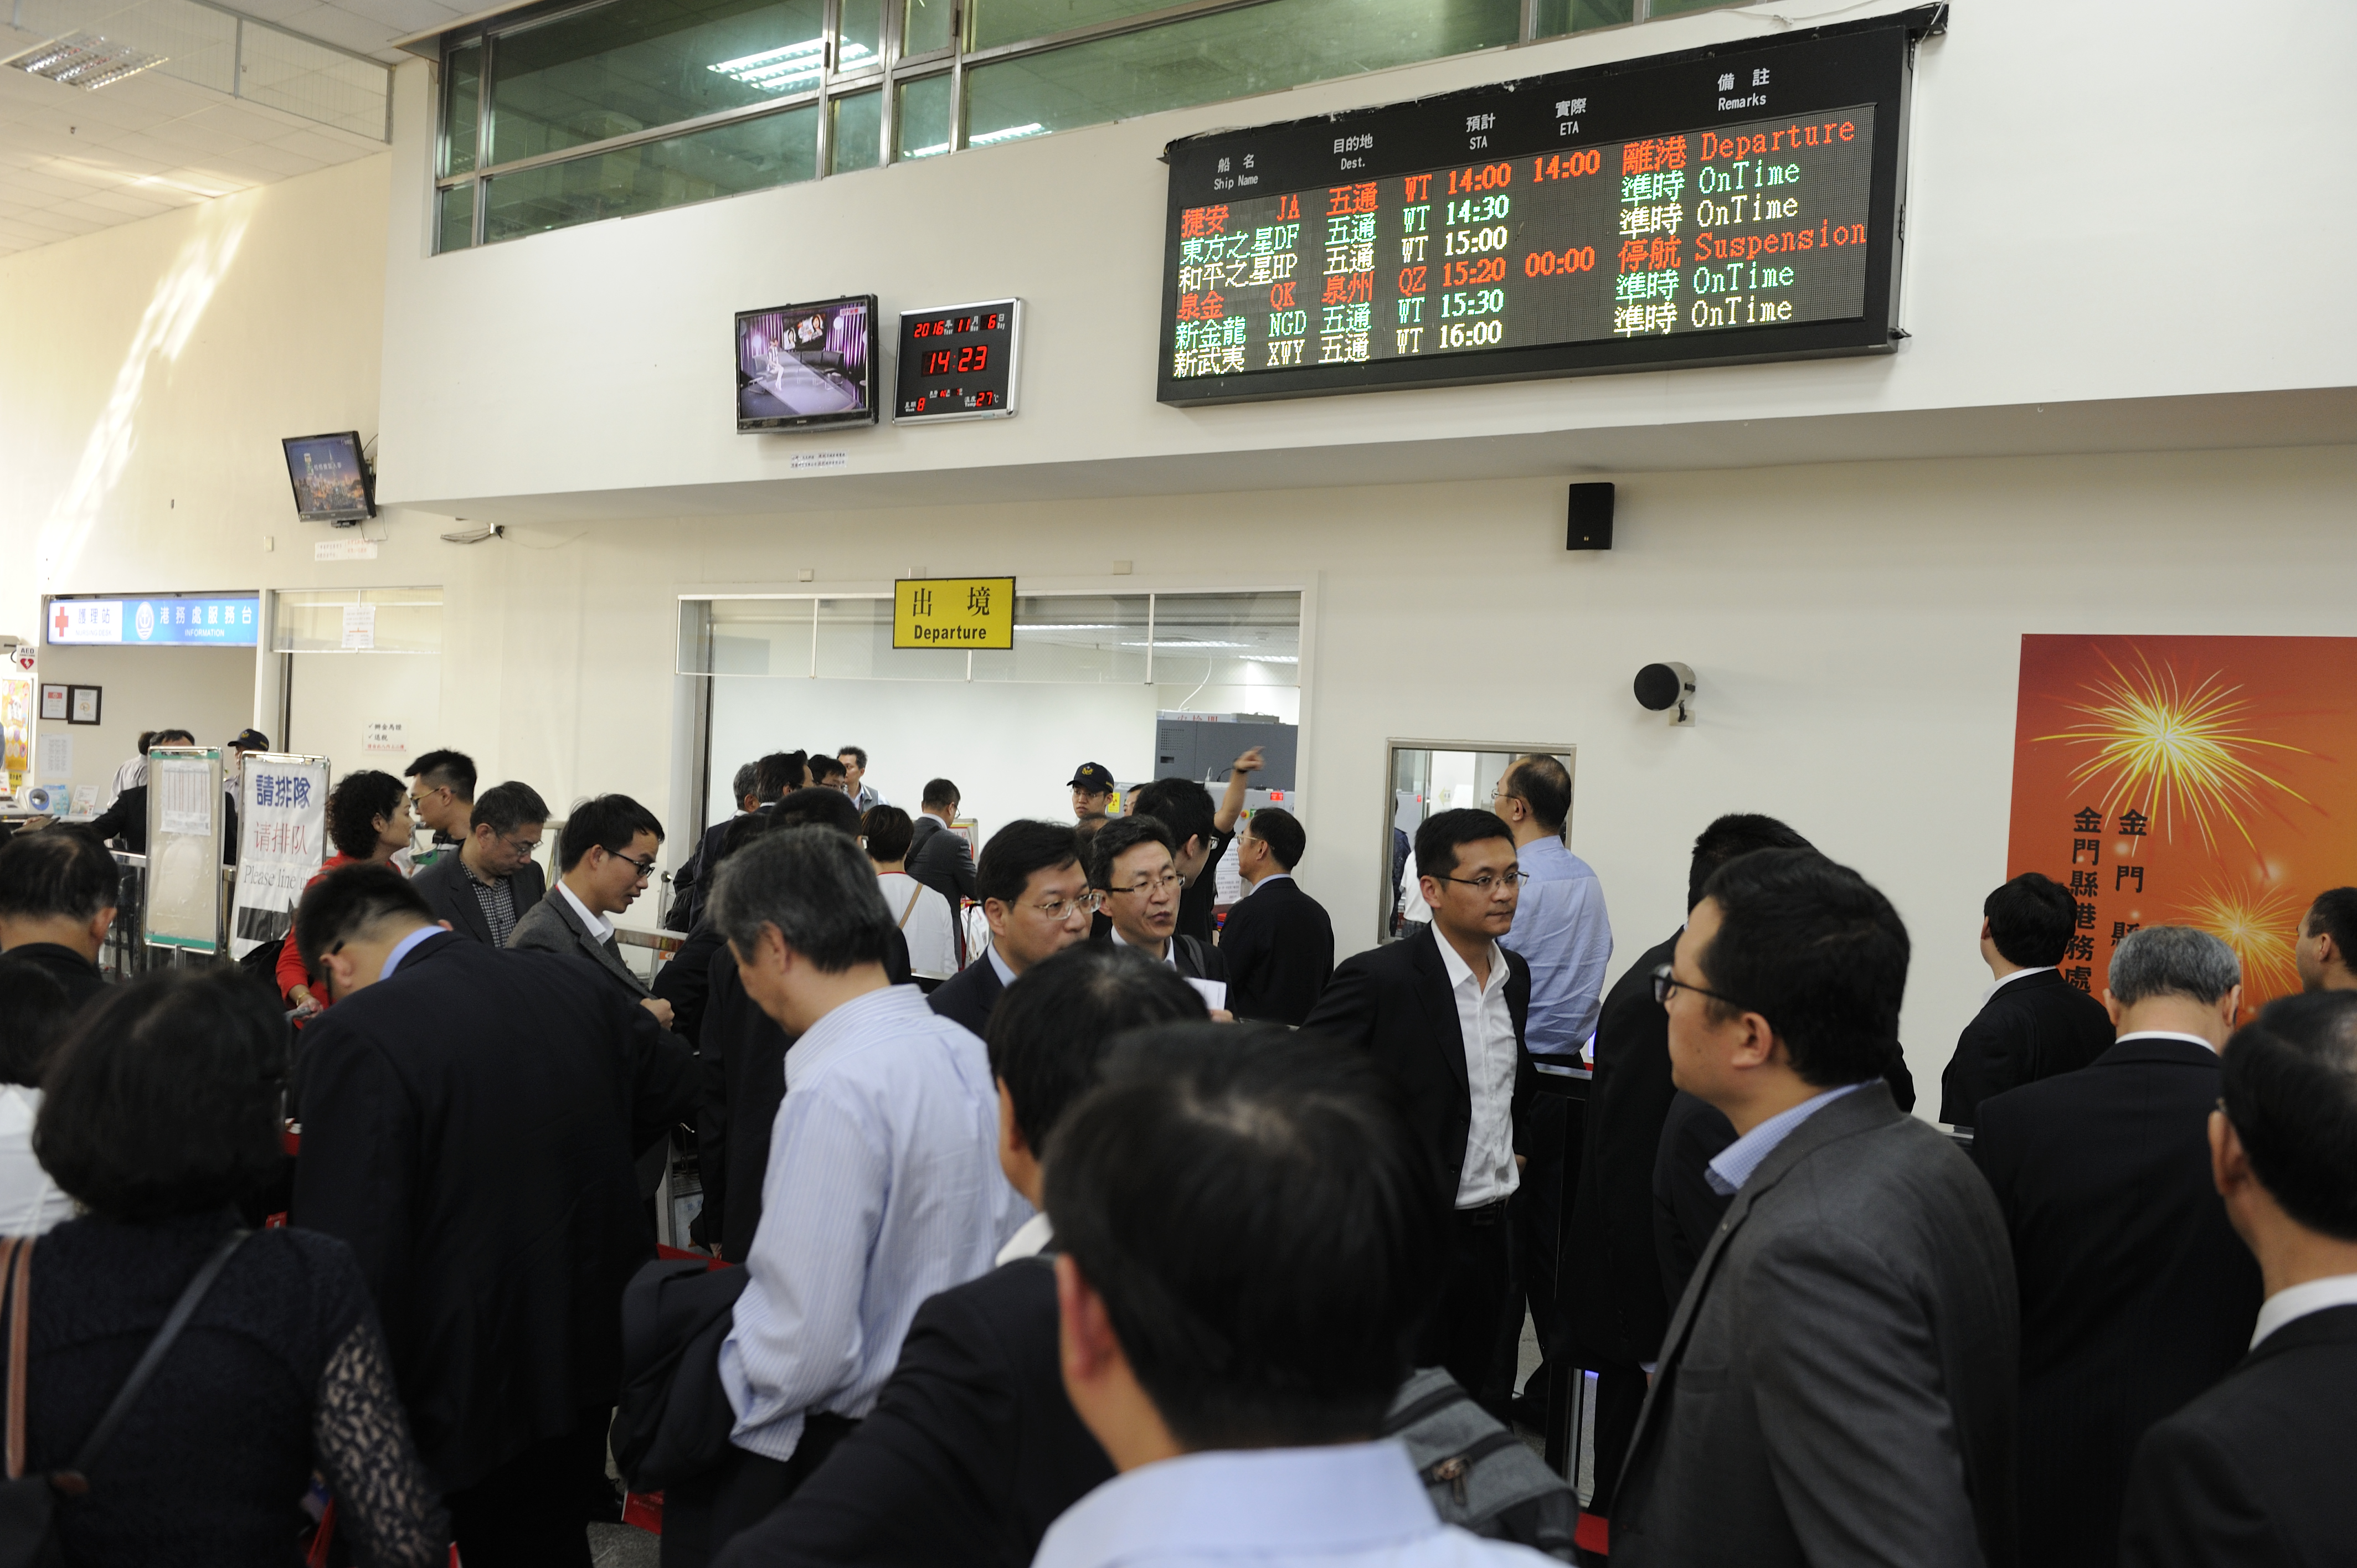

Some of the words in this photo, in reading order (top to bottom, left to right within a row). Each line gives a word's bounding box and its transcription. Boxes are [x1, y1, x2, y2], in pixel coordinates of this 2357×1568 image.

[1717, 69, 1770, 91] 備註
[1555, 97, 1587, 118] 實際
[1718, 94, 1766, 111] Remarks
[1466, 113, 1495, 131] 預計
[1560, 121, 1579, 136] ETA
[1334, 134, 1373, 153] 目的地
[1469, 138, 1488, 149] STA
[1218, 154, 1255, 173] 船名
[1341, 157, 1366, 170] Dest.
[1181, 205, 1229, 238] 捷安
[1277, 195, 1300, 221] JA
[1326, 182, 1378, 215] 五通
[1405, 174, 1432, 202] WT
[1447, 164, 1511, 194] 14:00
[1533, 149, 1601, 182] 14:00
[1622, 135, 1687, 176] 離港
[1700, 121, 1855, 162] Departure
[1214, 176, 1234, 190] Ship
[1238, 174, 1258, 187] Name
[1325, 212, 1376, 245] 五通
[1403, 205, 1430, 232] WT
[1445, 194, 1509, 225] 14:30
[1621, 169, 1685, 207] 準時
[1699, 159, 1800, 195] OnTime
[1324, 243, 1375, 275] 五通
[1402, 236, 1428, 262] WT
[1445, 226, 1507, 256] 15:00
[1619, 202, 1683, 239] 準時
[1697, 193, 1798, 228] OnTime
[1177, 290, 1223, 320] 泉金
[1270, 282, 1296, 310] QK
[1322, 271, 1373, 305] 泉州
[1398, 267, 1427, 296] QZ
[1443, 257, 1505, 287] 15:20
[1525, 246, 1596, 277] 00:00
[1618, 235, 1682, 273] 停航
[1695, 218, 1866, 262] Suspension
[1176, 316, 1246, 349] 新金龍
[1269, 311, 1306, 337] NGD
[1320, 302, 1371, 334] 五通
[1398, 297, 1425, 323] WT
[1441, 289, 1504, 318] 15:30
[1615, 269, 1680, 305] 準時
[1694, 261, 1794, 295] OnTime
[914, 320, 944, 338] 2016
[958, 318, 970, 332] 11
[987, 314, 996, 329] 6
[1174, 345, 1246, 378] 新武夷
[1267, 339, 1305, 367] XWY
[1319, 332, 1370, 364] 五通
[1397, 328, 1423, 354] WT
[1439, 320, 1502, 349] 16:00
[1614, 302, 1677, 337] 準時
[1691, 295, 1792, 329] OnTime
[929, 346, 987, 373] 14:23
[976, 392, 993, 406] 27
[913, 587, 990, 617] 出境
[78, 608, 110, 624] 護理站
[160, 606, 252, 625] 港務處服務台
[914, 625, 986, 643] Departure
[256, 774, 310, 809] 請排隊
[254, 821, 307, 854] 请排队
[244, 865, 275, 886] Please
[277, 869, 296, 889] line
[2065, 806, 2102, 993] 金門縣港務處
